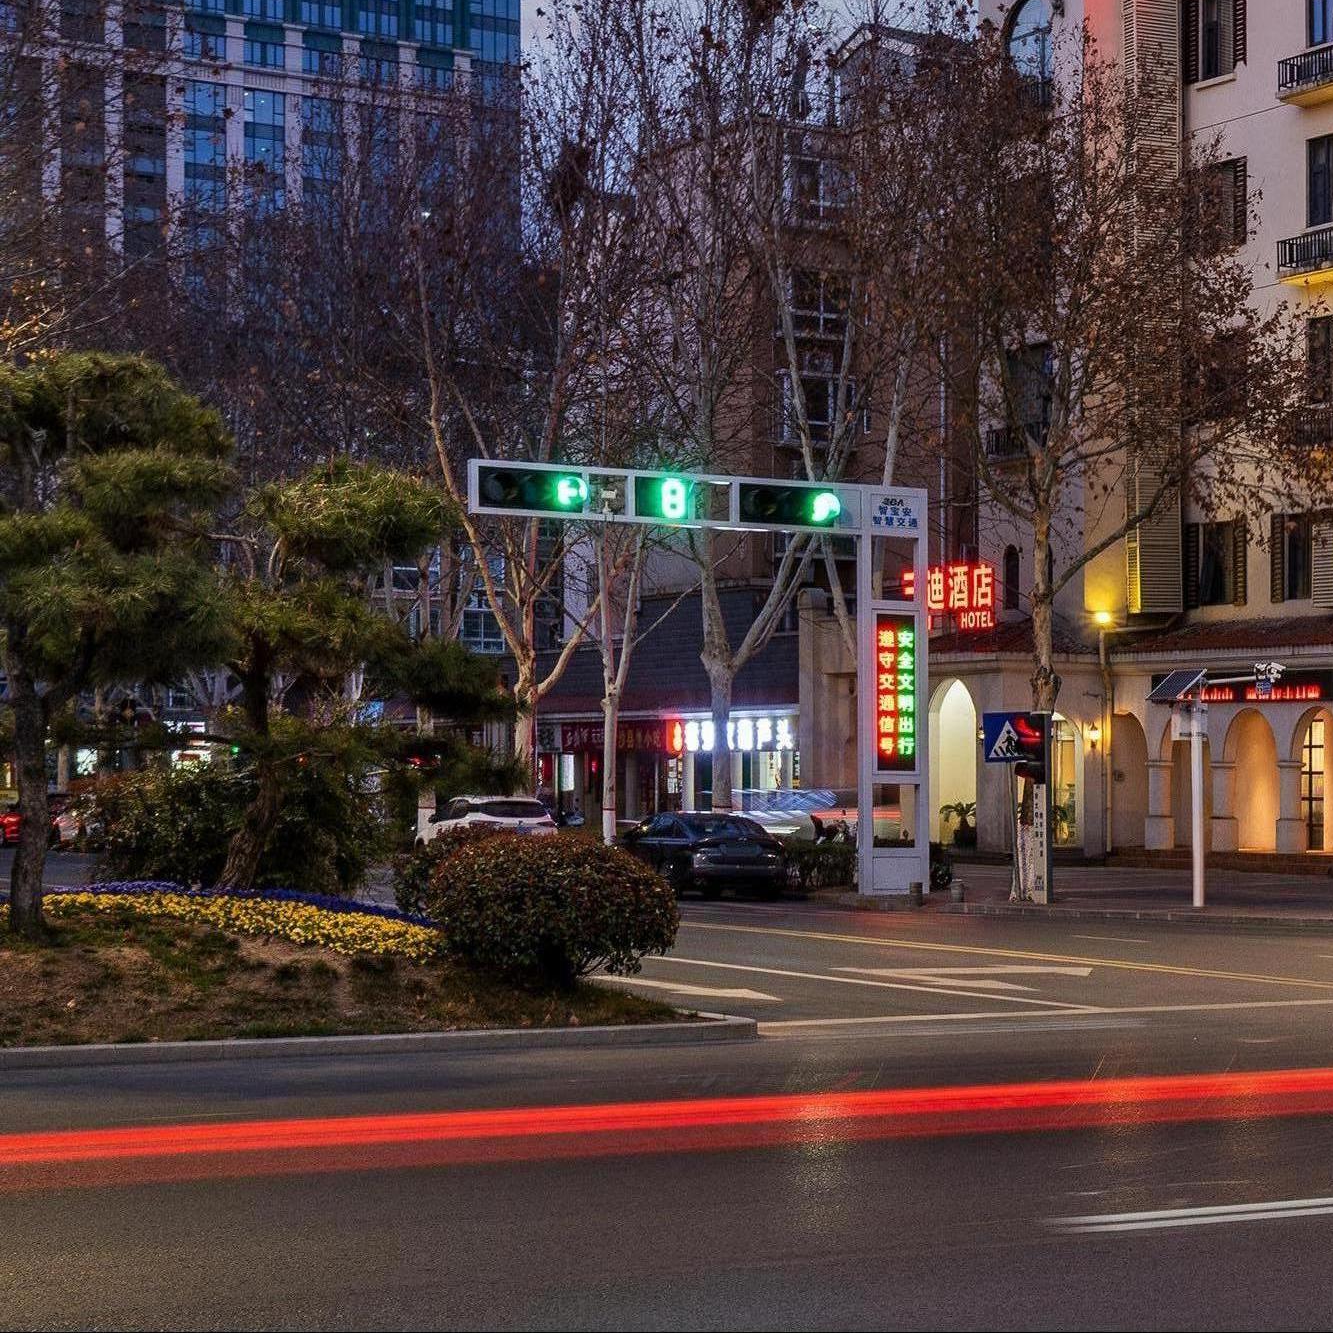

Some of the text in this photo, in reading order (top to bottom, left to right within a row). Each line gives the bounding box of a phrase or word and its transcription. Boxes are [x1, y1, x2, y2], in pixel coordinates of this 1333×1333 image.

[661, 478, 687, 519] 8
[961, 611, 993, 628] HOTEL
[897, 630, 914, 755] 安全文明出行
